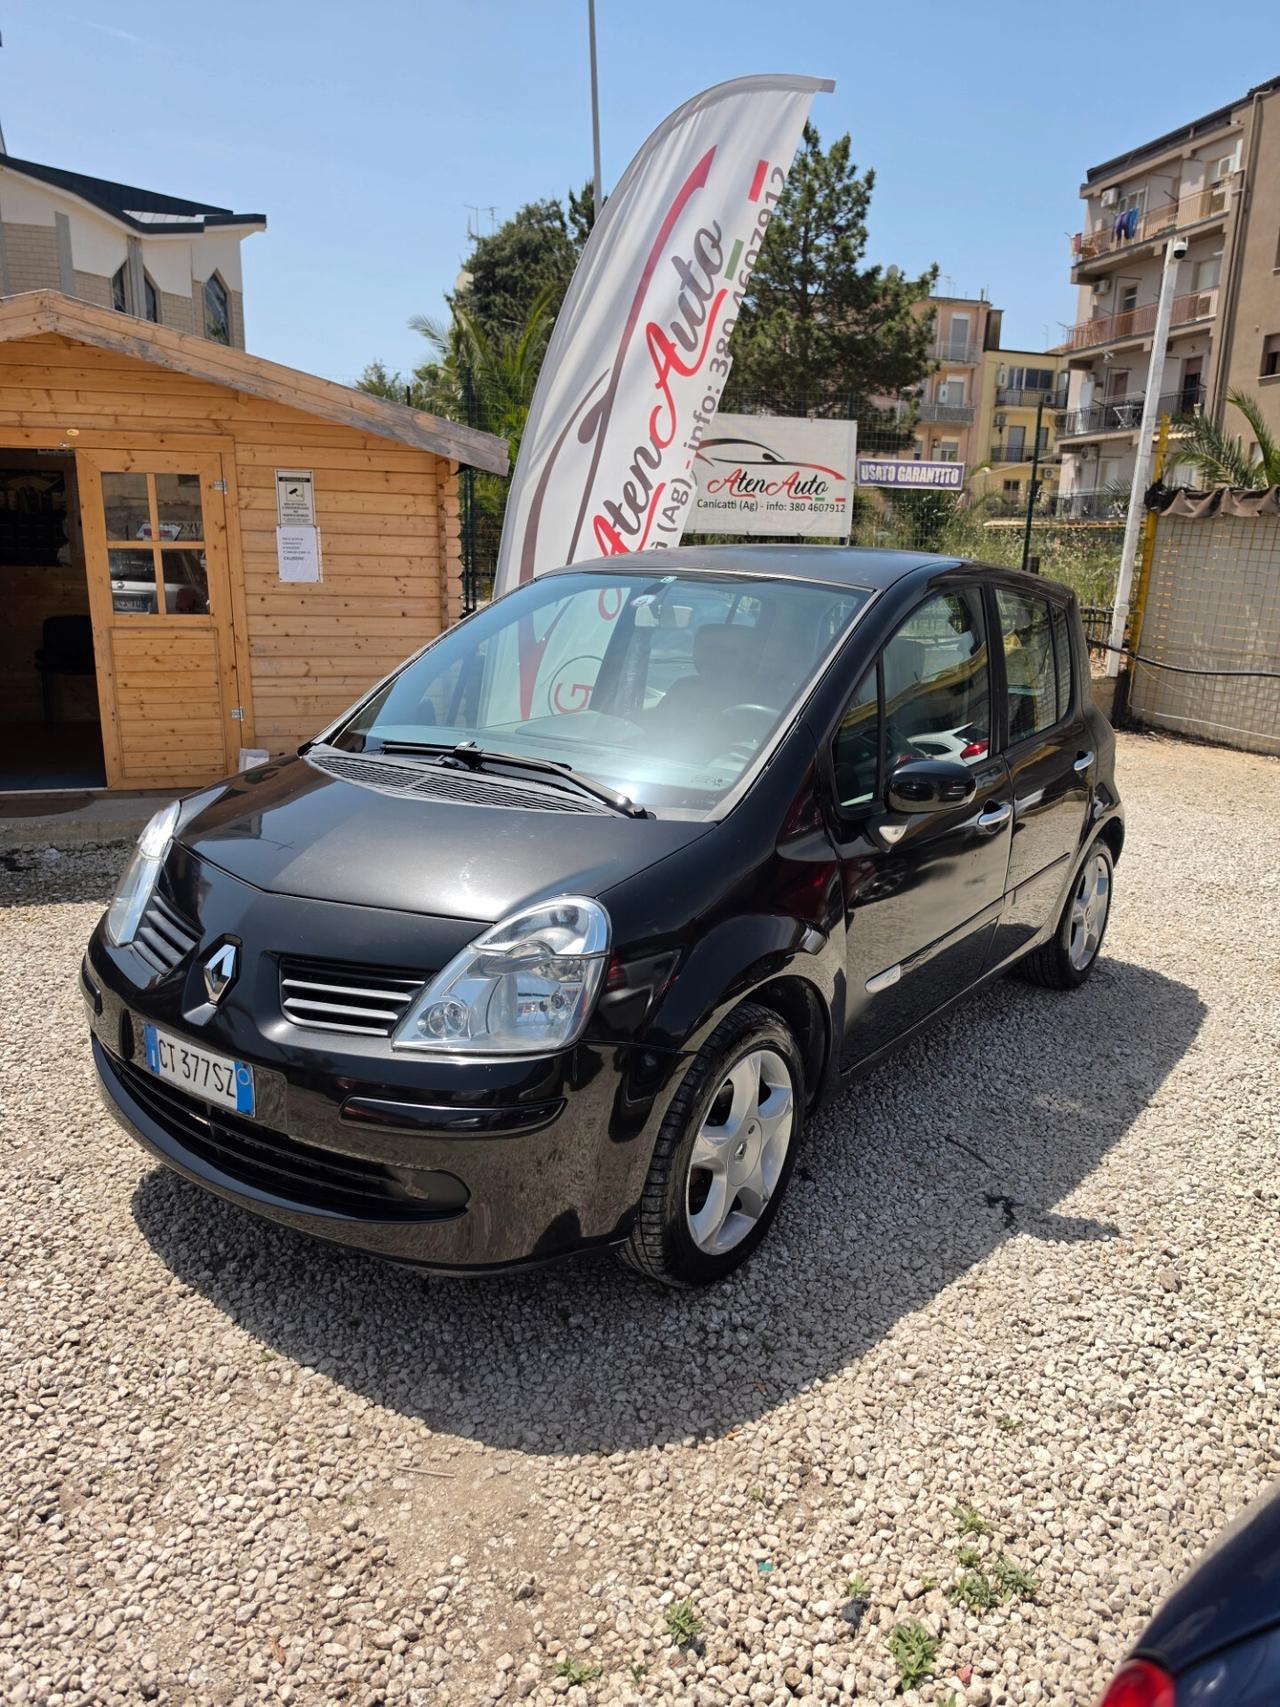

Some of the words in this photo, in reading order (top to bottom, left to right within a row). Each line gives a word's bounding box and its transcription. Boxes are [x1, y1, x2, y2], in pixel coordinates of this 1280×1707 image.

[593, 219, 728, 557] AtenAuto
[657, 477, 692, 532] (Ag)
[683, 385, 721, 451] info:
[709, 318, 737, 378] 380
[706, 468, 829, 500] AtenAuto
[861, 464, 896, 482] USATO
[897, 466, 959, 484] GARANTITO
[739, 500, 758, 512] (Ag)
[766, 501, 787, 511] info:
[789, 502, 806, 512] 380
[807, 503, 846, 513] 4607912
[158, 1039, 177, 1073] CT
[180, 1049, 237, 1098] 377SZ
